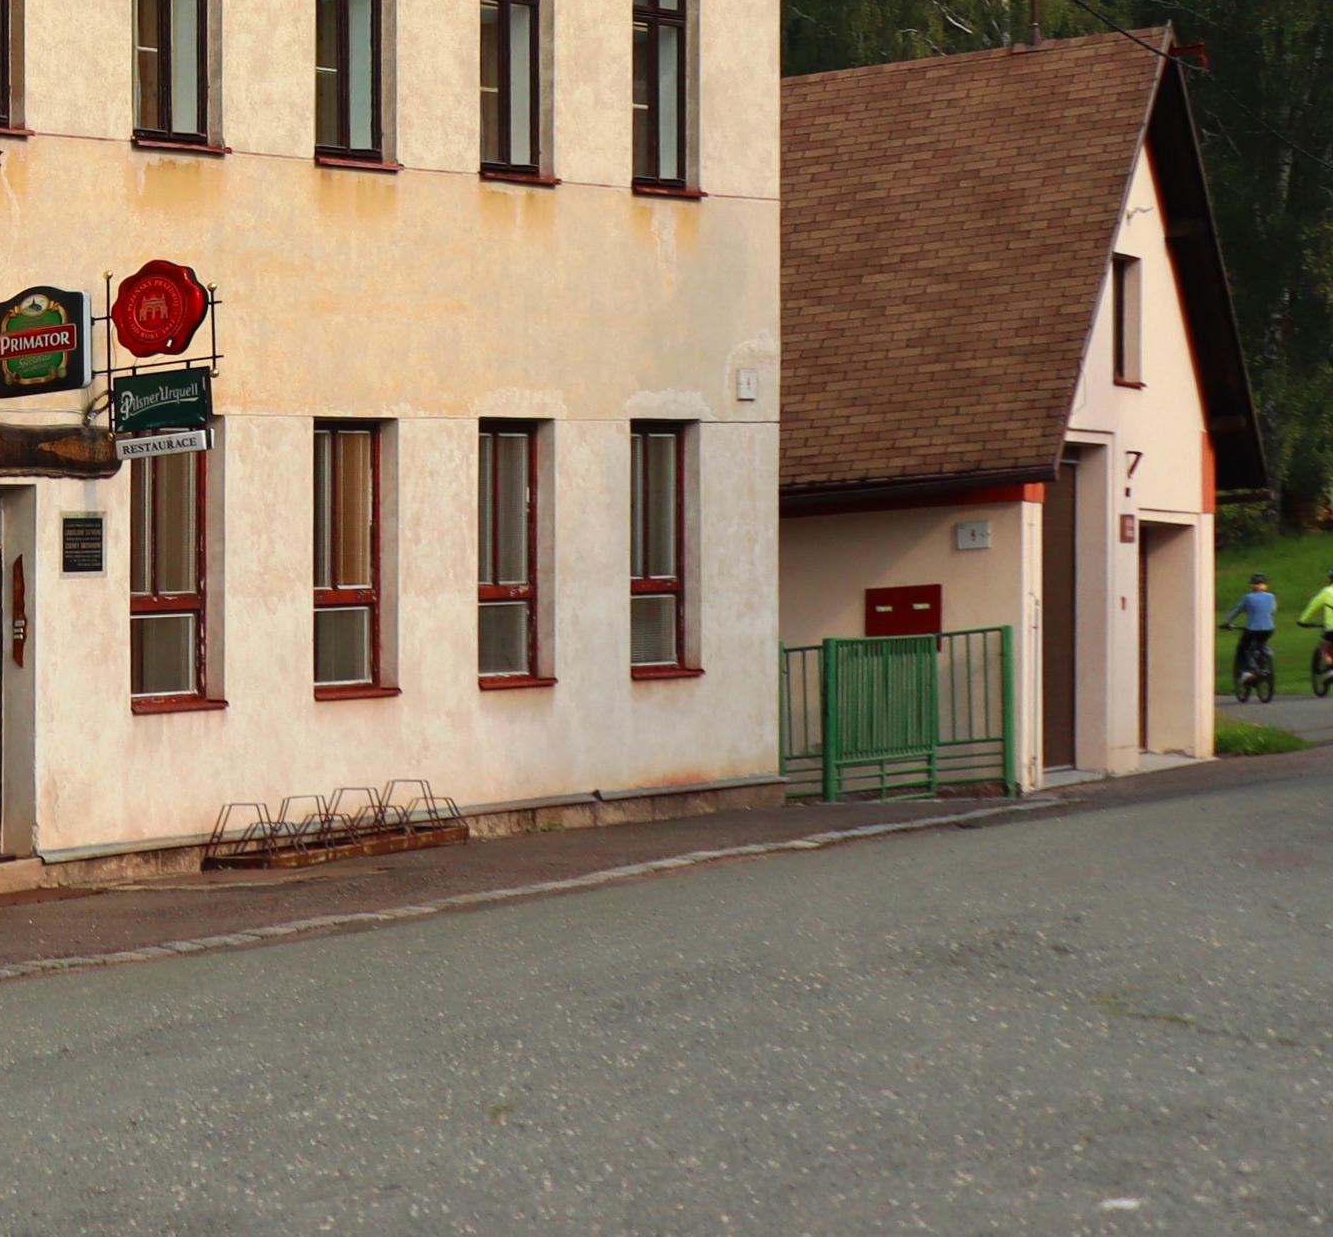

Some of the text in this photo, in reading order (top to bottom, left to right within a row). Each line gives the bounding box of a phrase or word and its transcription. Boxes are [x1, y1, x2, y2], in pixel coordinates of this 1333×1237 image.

[0, 331, 71, 356] PRIMATOR
[120, 382, 198, 421] Pilsner Urquell
[122, 436, 198, 455] RESTAURACE
